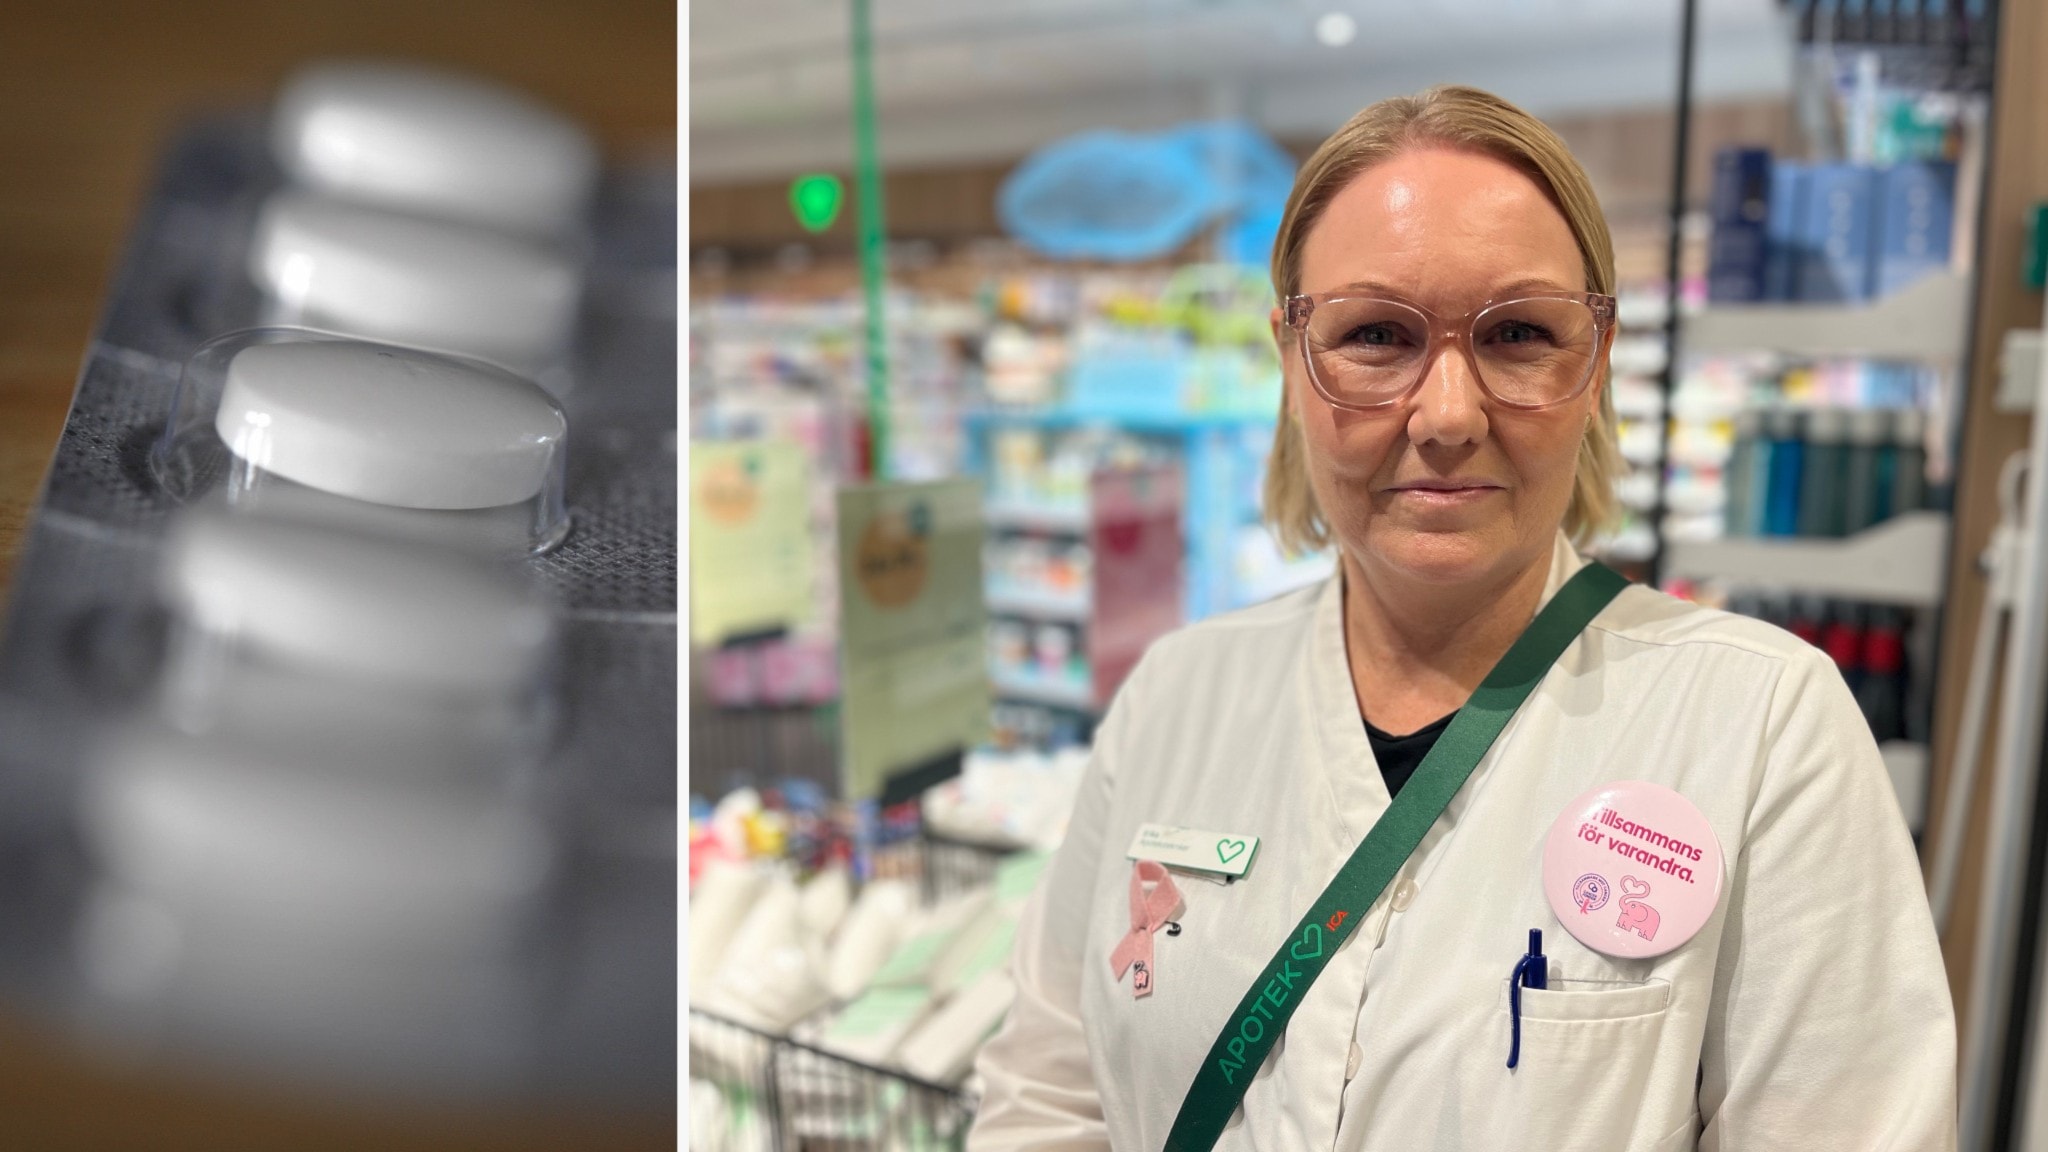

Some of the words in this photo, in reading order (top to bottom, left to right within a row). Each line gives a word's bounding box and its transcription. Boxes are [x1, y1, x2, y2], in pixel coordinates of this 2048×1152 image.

[1577, 822, 1605, 845] för
[1608, 837, 1695, 884] varandra.
[1218, 960, 1303, 1085] APOTEK
[1326, 910, 1349, 932] ICA
